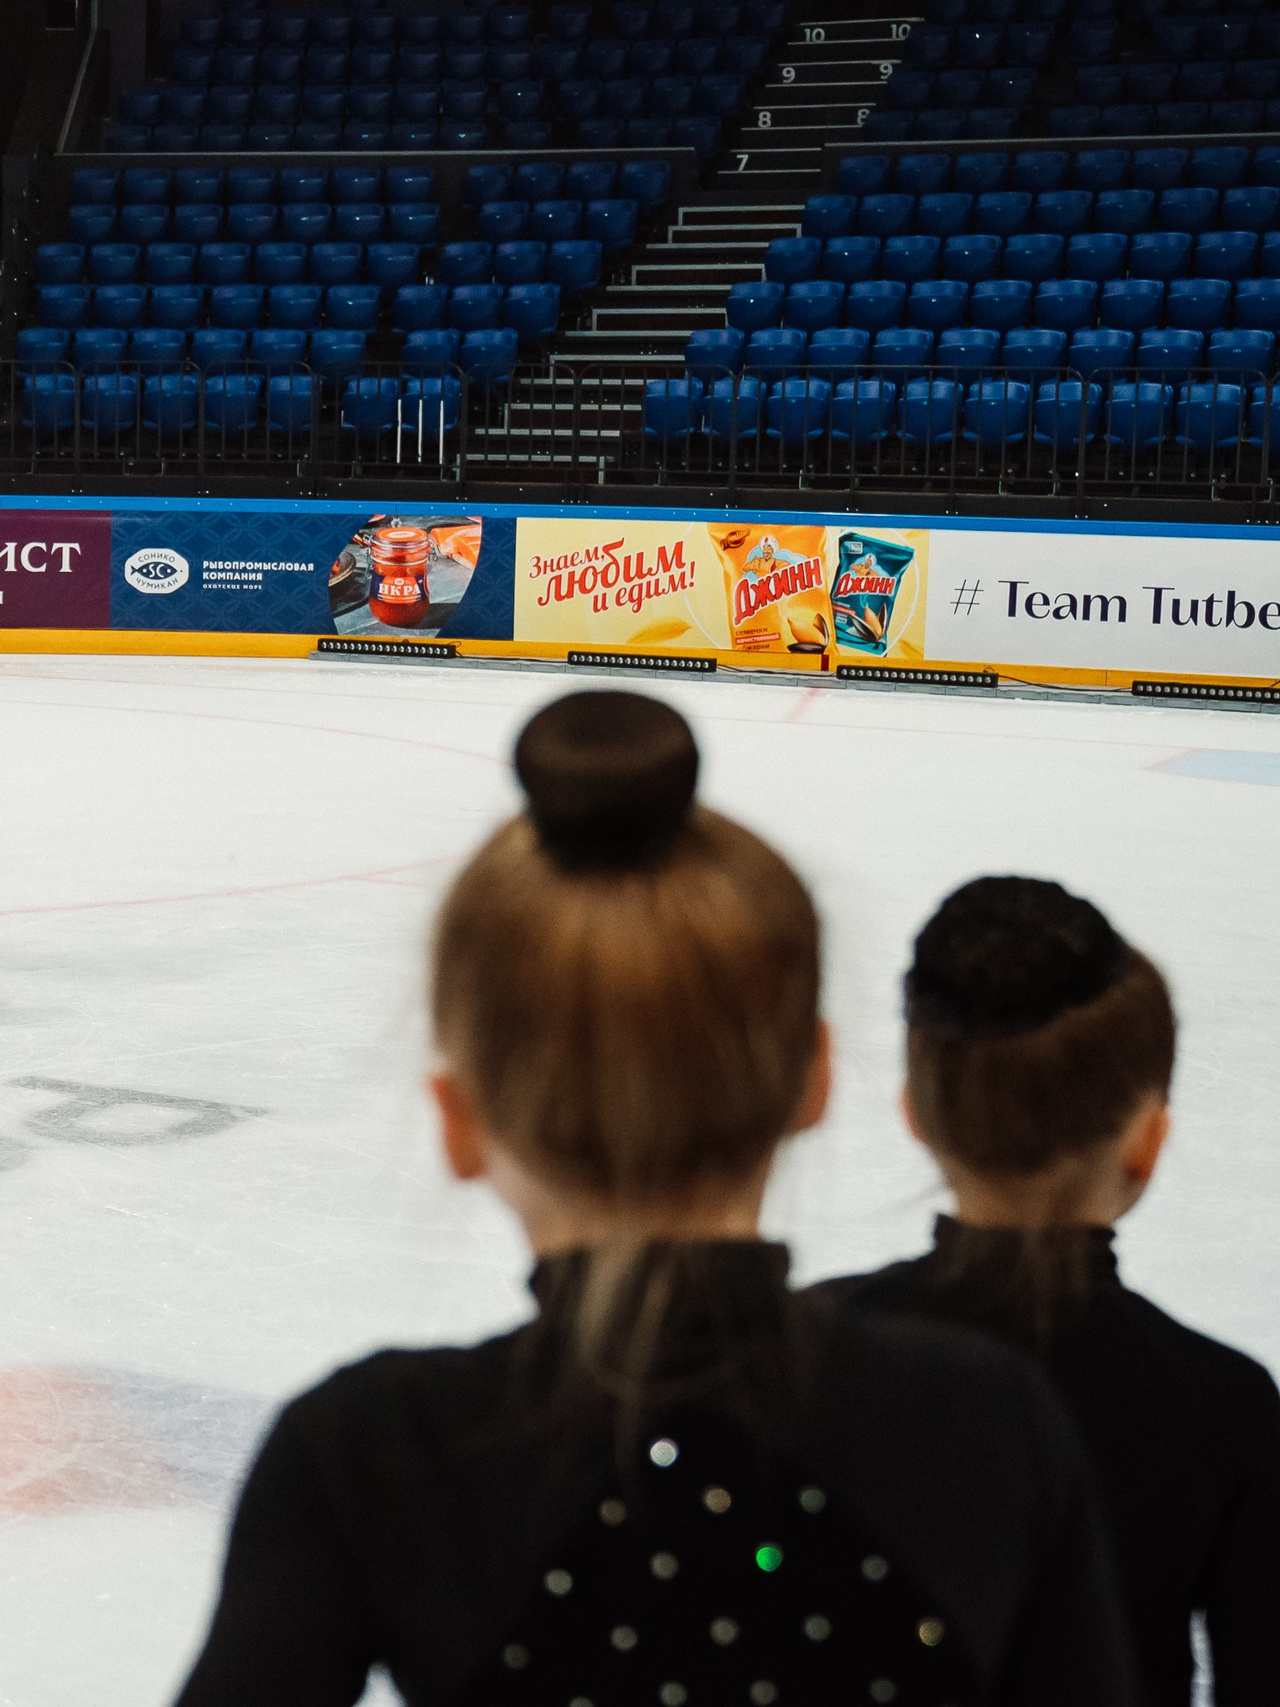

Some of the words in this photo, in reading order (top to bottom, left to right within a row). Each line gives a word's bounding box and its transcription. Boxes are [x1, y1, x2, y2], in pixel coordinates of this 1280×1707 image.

[804, 28, 825, 43] 10
[891, 24, 911, 39] 10
[782, 67, 795, 84] 9
[879, 63, 893, 79] 9
[757, 111, 771, 128] 8
[736, 154, 749, 171] 7
[138, 552, 175, 562] СОНИКО
[529, 546, 605, 579] Знаем,
[202, 560, 314, 571] РЫБОПРОМЫСЛОВАЯ
[537, 537, 686, 607] любим
[136, 577, 179, 589] ЧУМИКАН
[202, 572, 263, 581] КОМПАНИЯ
[378, 583, 421, 596] ИКРА
[593, 593, 609, 614] и
[615, 561, 696, 614] едим!
[998, 580, 1128, 624] Team
[1142, 586, 1280, 630] Tutbe
